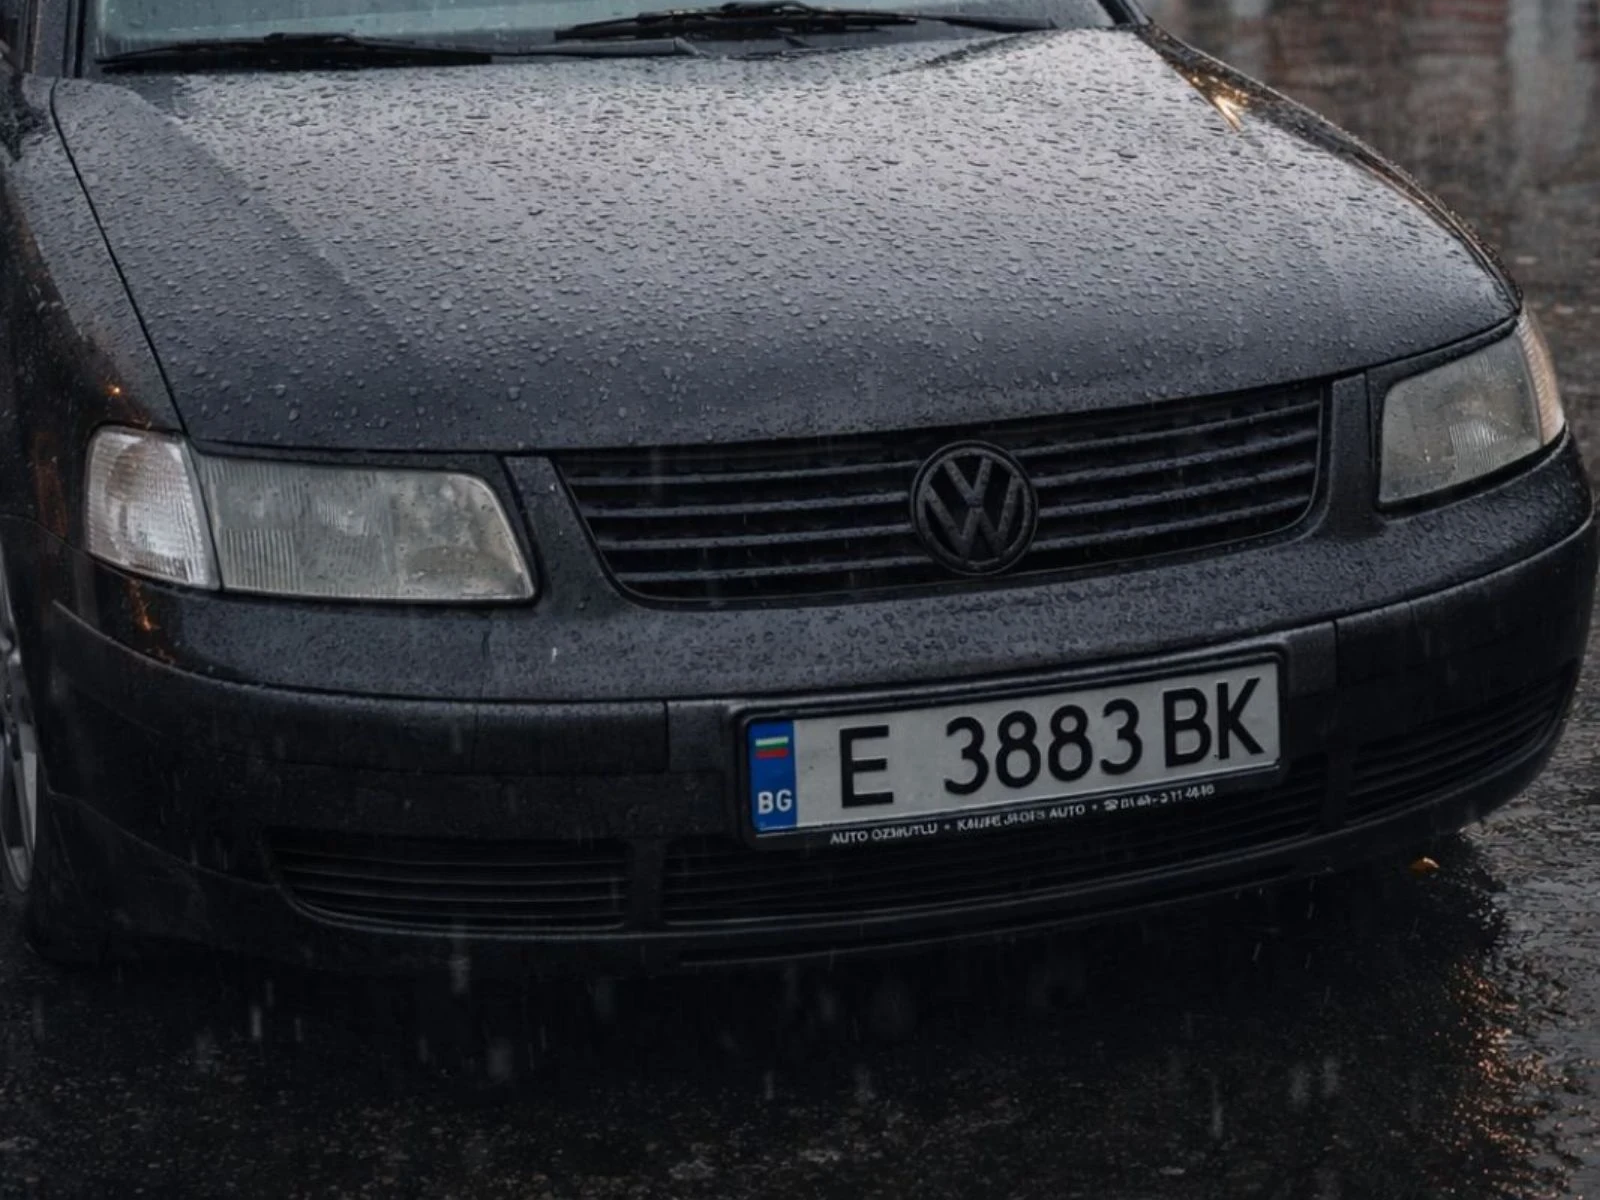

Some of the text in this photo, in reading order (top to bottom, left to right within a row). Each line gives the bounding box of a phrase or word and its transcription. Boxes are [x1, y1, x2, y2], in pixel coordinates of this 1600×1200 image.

[839, 678, 1265, 809] E 3883 BK
[758, 789, 793, 815] BG
[830, 831, 868, 845] AUTO
[1049, 804, 1085, 819] AUTO
